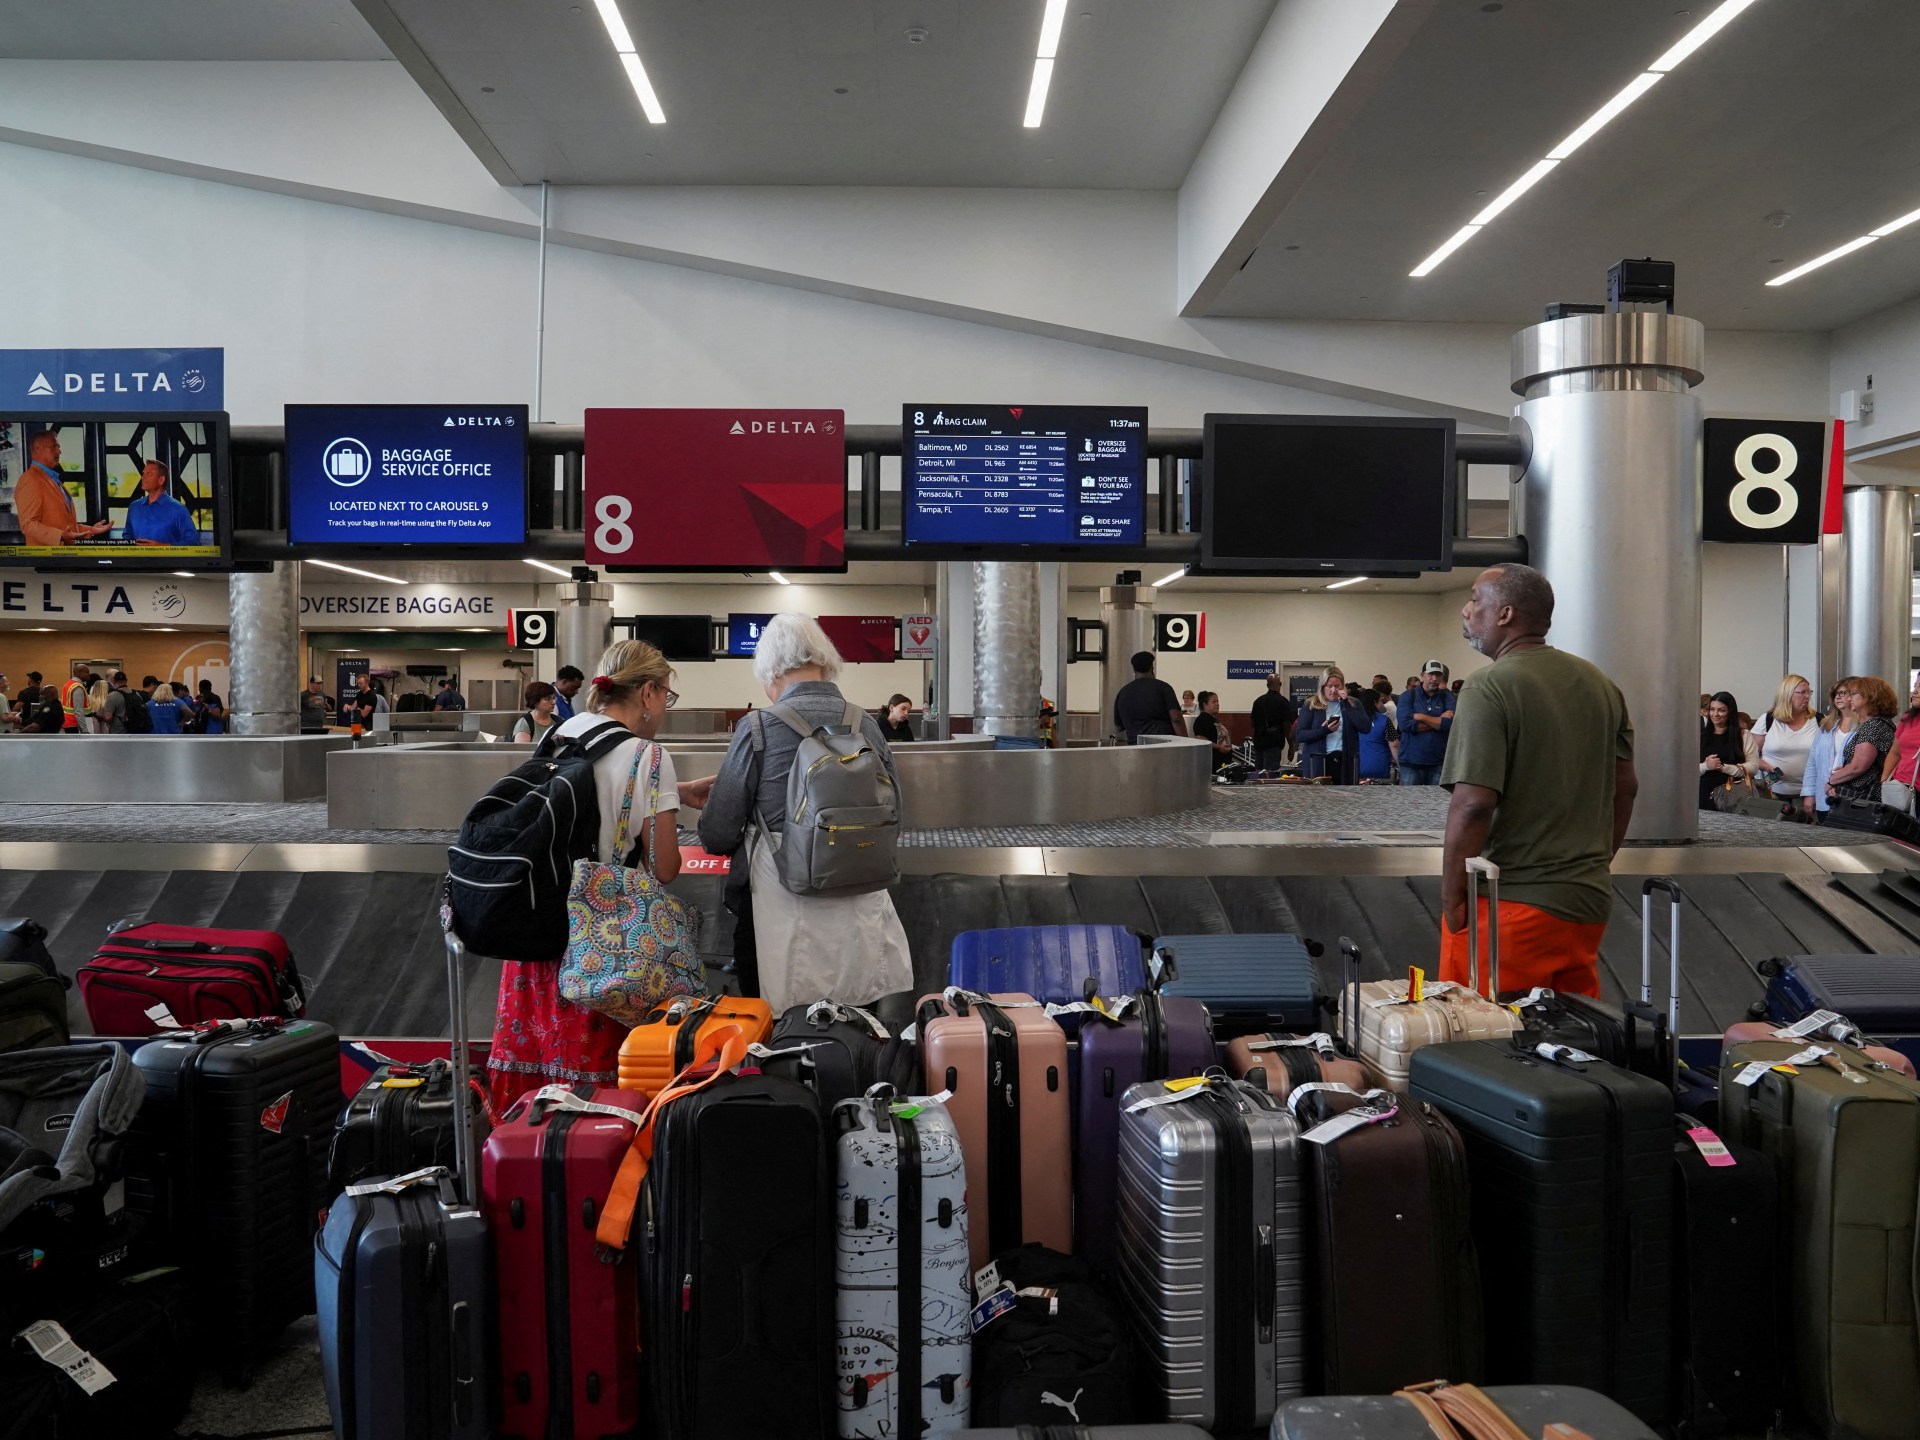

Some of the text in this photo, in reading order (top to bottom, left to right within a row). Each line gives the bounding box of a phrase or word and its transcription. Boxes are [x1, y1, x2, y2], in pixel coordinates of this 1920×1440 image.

[64, 372, 172, 392] DELTA
[458, 417, 502, 426] DELTA
[914, 412, 924, 426] 8
[752, 422, 816, 434] DELTA
[382, 449, 452, 462] BAGGAGE
[382, 464, 492, 476] SERVICE OFFICE
[1729, 433, 1798, 529] 8
[330, 502, 488, 510] LOCATED NEXT TO CAROUSEL 9
[919, 506, 942, 514] Tampa,
[594, 494, 634, 554] 8
[3, 582, 134, 614] ELTA
[300, 597, 494, 613] OVERSIZE BAGGAGE
[524, 614, 546, 645] 9
[1166, 618, 1190, 648] 9
[686, 860, 719, 868] OFF
[853, 1346, 870, 1354] 30
[858, 1360, 866, 1368] 7
